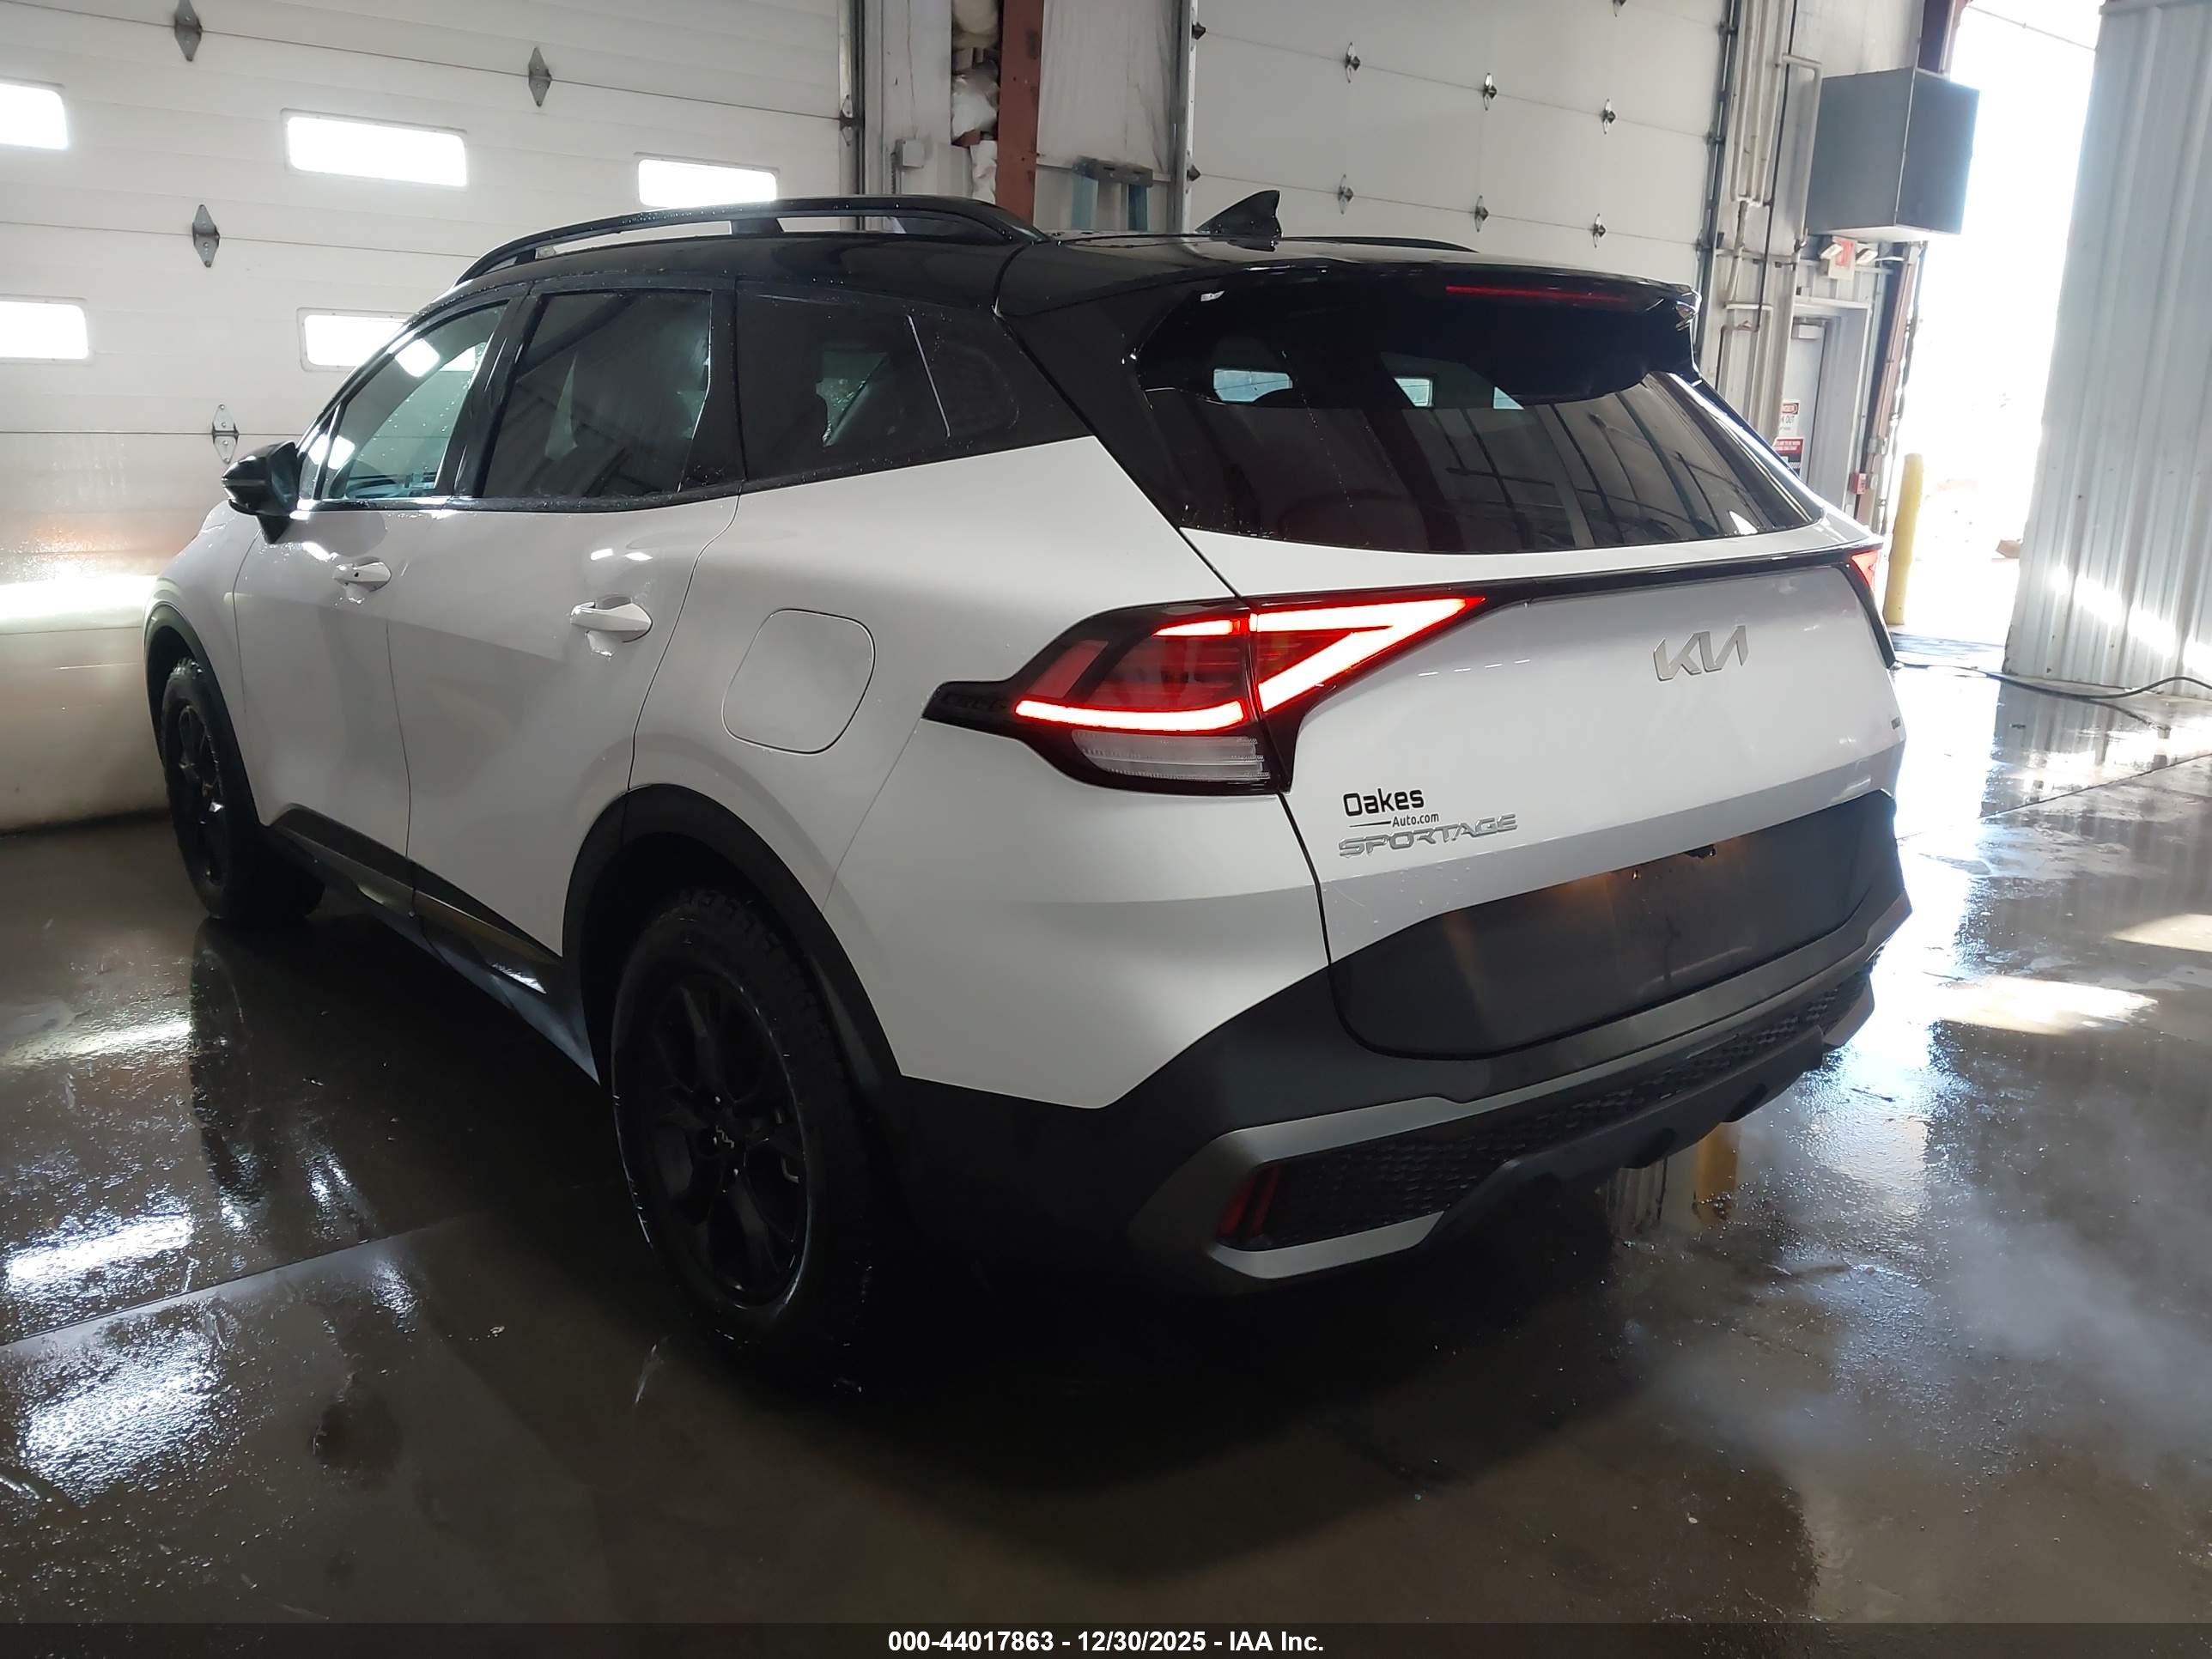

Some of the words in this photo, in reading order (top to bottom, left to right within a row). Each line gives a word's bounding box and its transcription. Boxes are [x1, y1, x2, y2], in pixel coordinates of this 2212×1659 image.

[1343, 788, 1425, 817] Oakes
[1392, 812, 1439, 828] Auto.com
[1338, 814, 1518, 858] SPORTAGE
